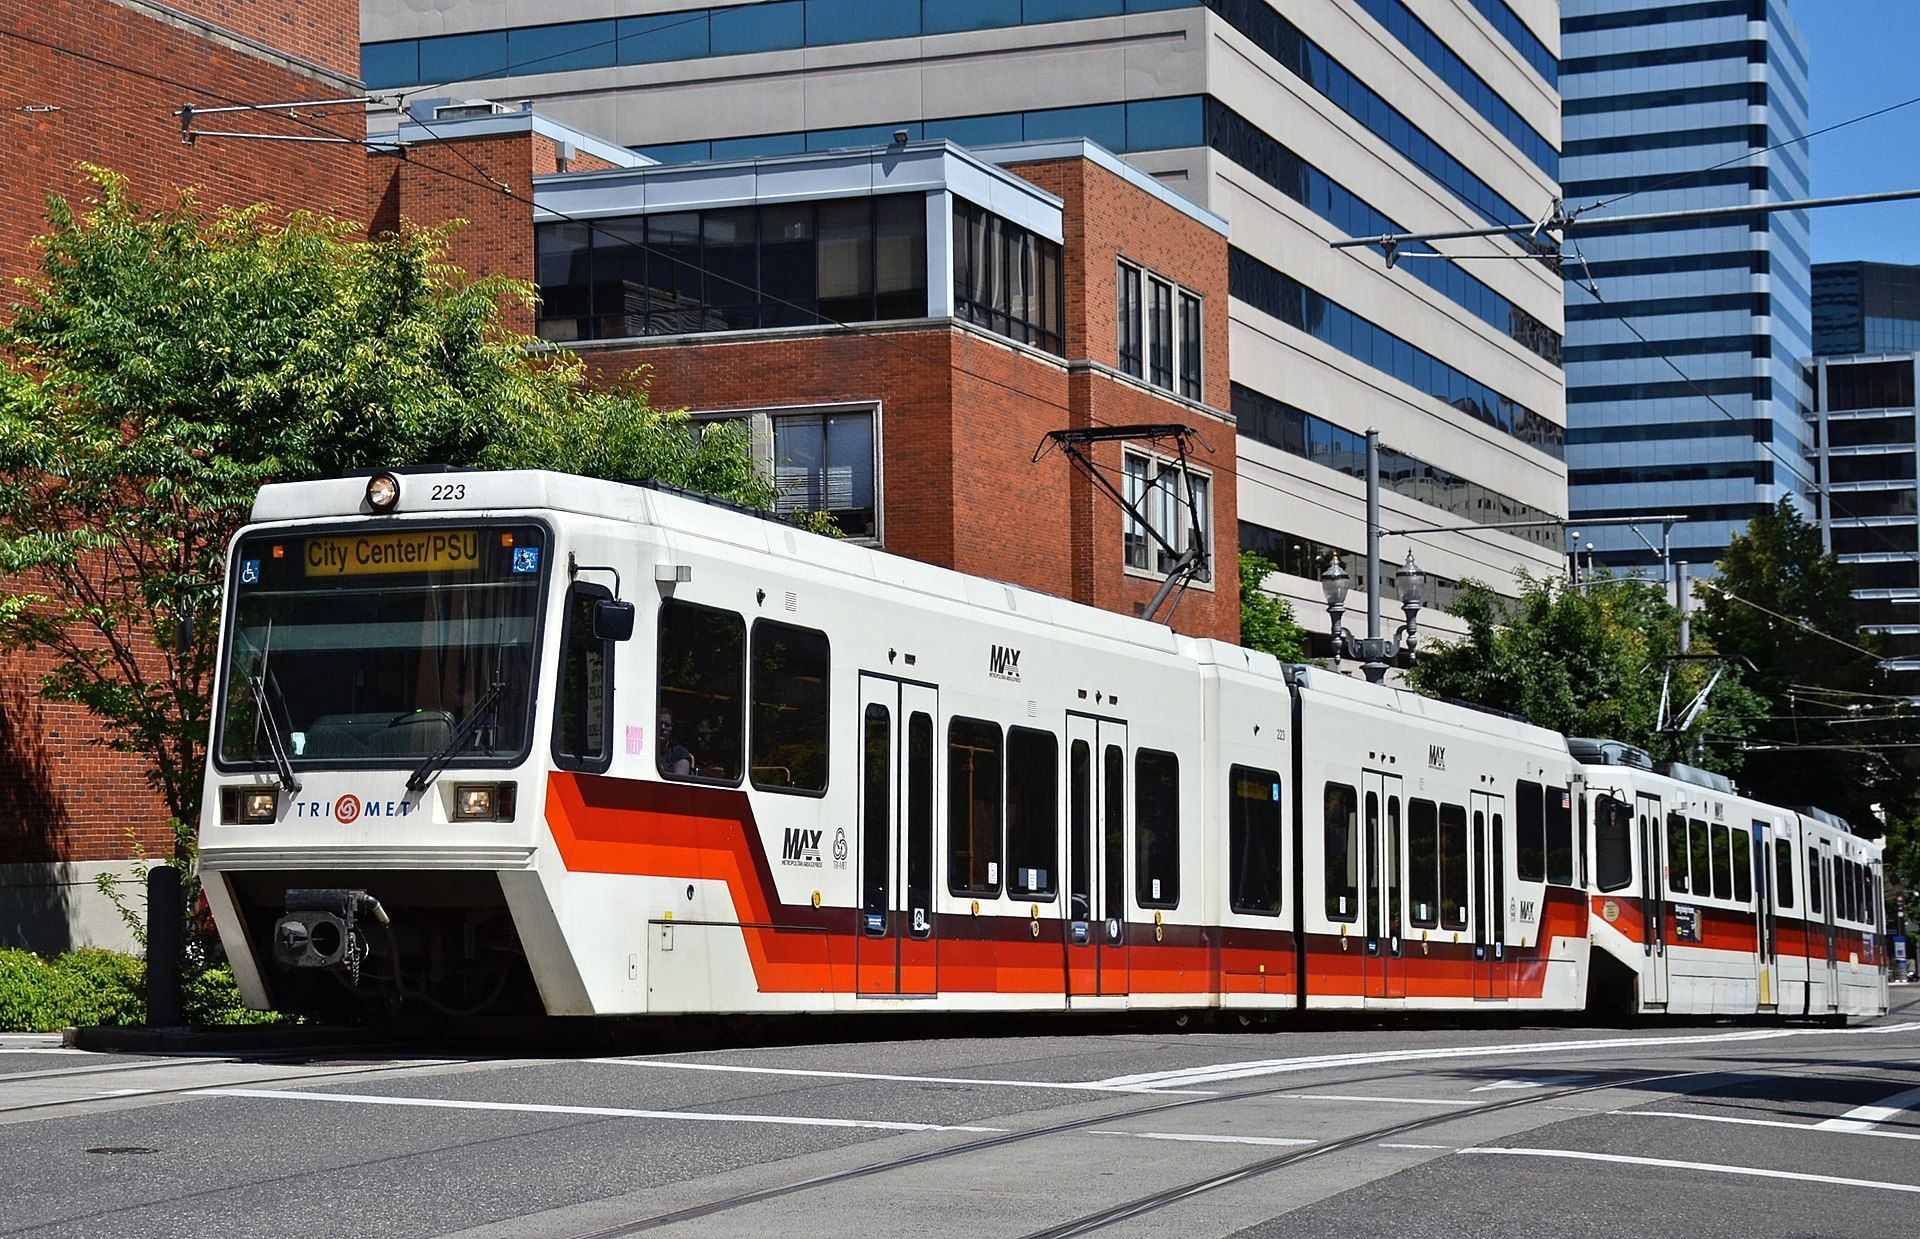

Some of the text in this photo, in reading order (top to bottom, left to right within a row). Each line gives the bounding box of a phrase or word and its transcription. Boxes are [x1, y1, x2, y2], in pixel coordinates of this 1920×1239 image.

[431, 485, 465, 500] 223
[308, 533, 477, 572] City Center/PSU
[990, 644, 1021, 677] MAX
[1276, 729, 1285, 740] 223
[626, 739, 643, 754] HELP
[297, 801, 411, 817] TRI MET
[782, 827, 823, 861] MAX
